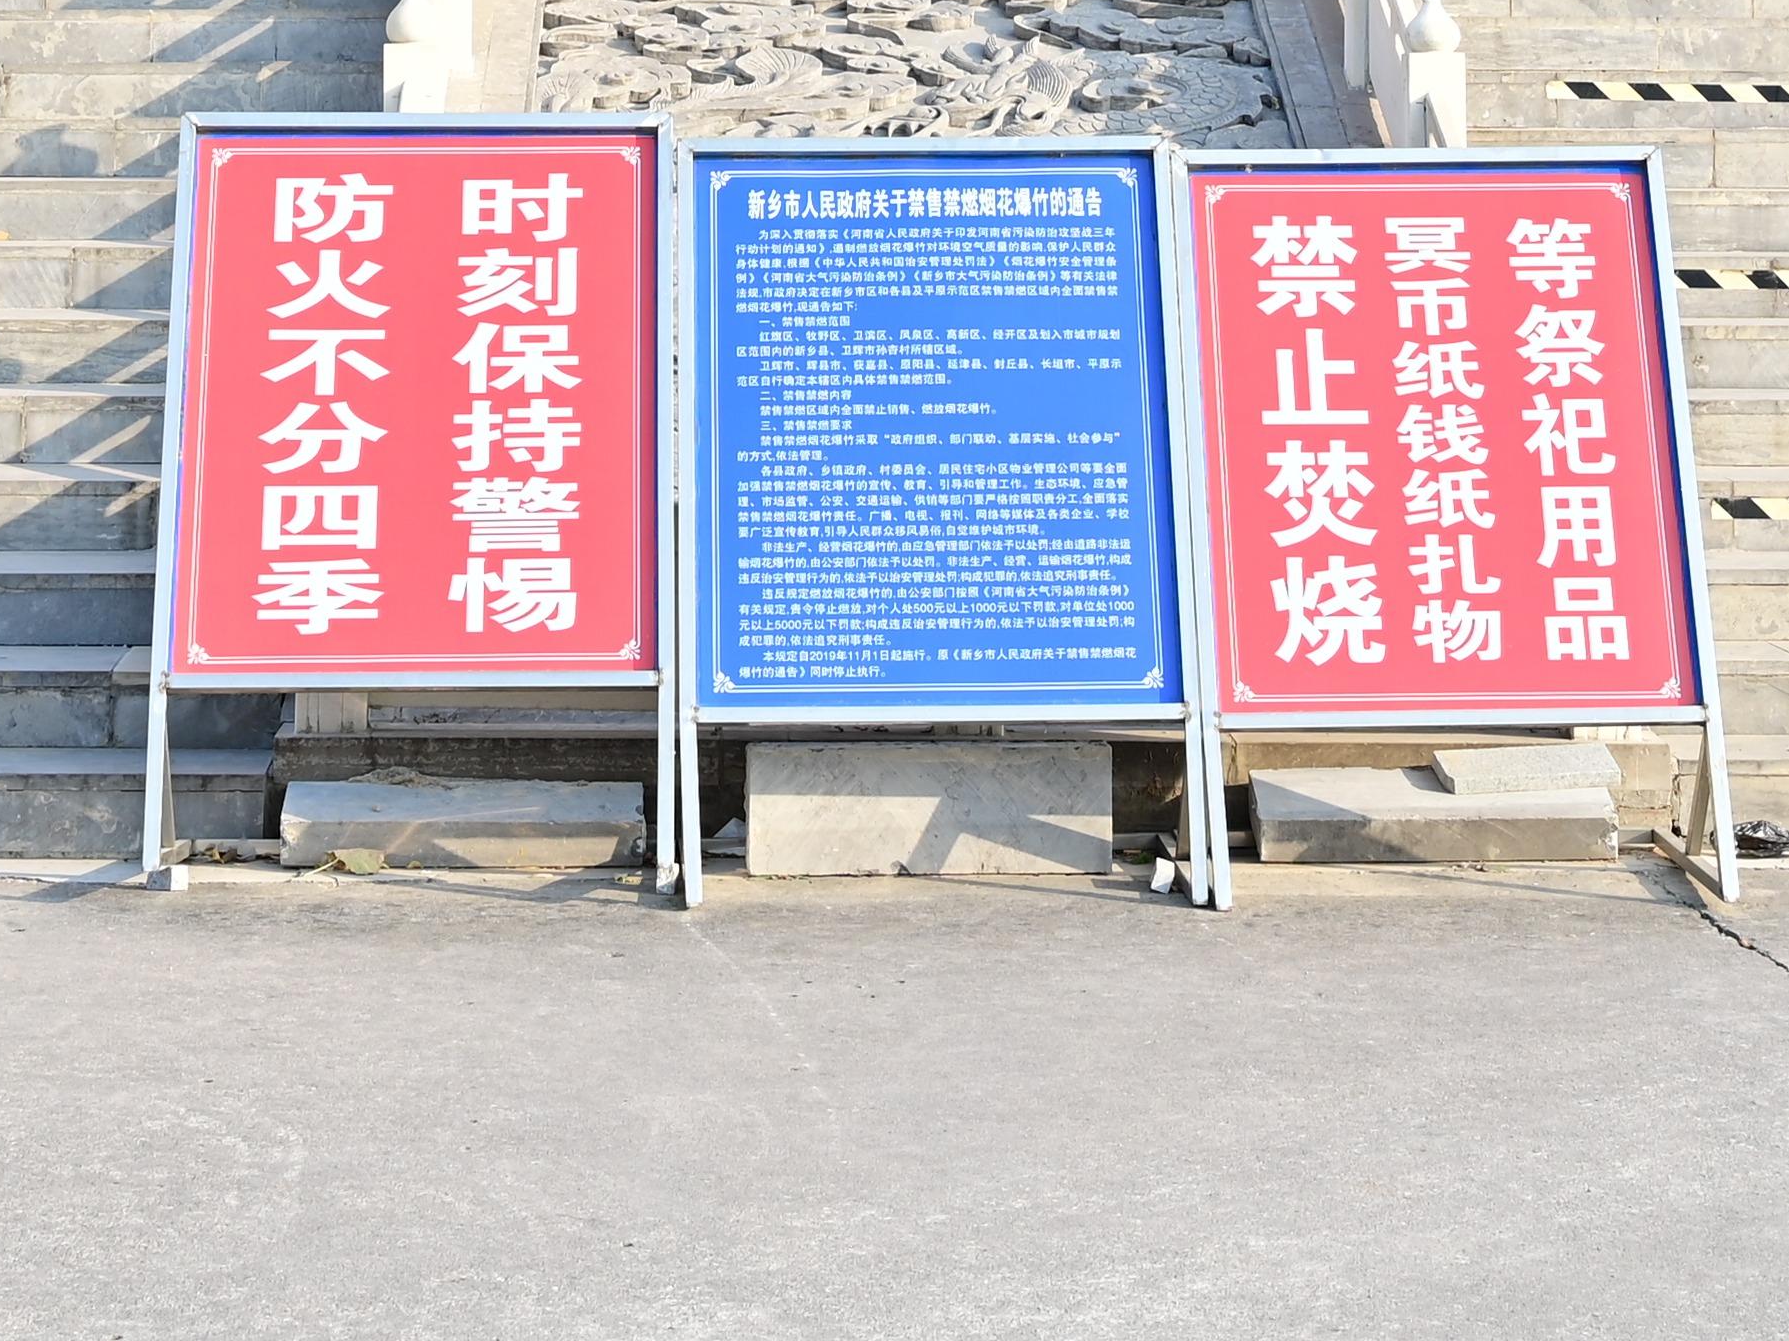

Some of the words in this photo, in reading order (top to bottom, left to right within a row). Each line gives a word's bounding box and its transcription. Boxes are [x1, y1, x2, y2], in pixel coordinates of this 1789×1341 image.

[253, 172, 395, 632] 防火不分四季
[448, 172, 584, 633] 时刻保持警惕
[748, 187, 1102, 219] 新乡市人民政府关于禁售禁燃烟花爆竹的通告
[1252, 215, 1386, 666] 禁止焚烧
[1384, 215, 1502, 664] 冥币纸钱纸扎物
[1507, 218, 1632, 663] 等祭祀用品
